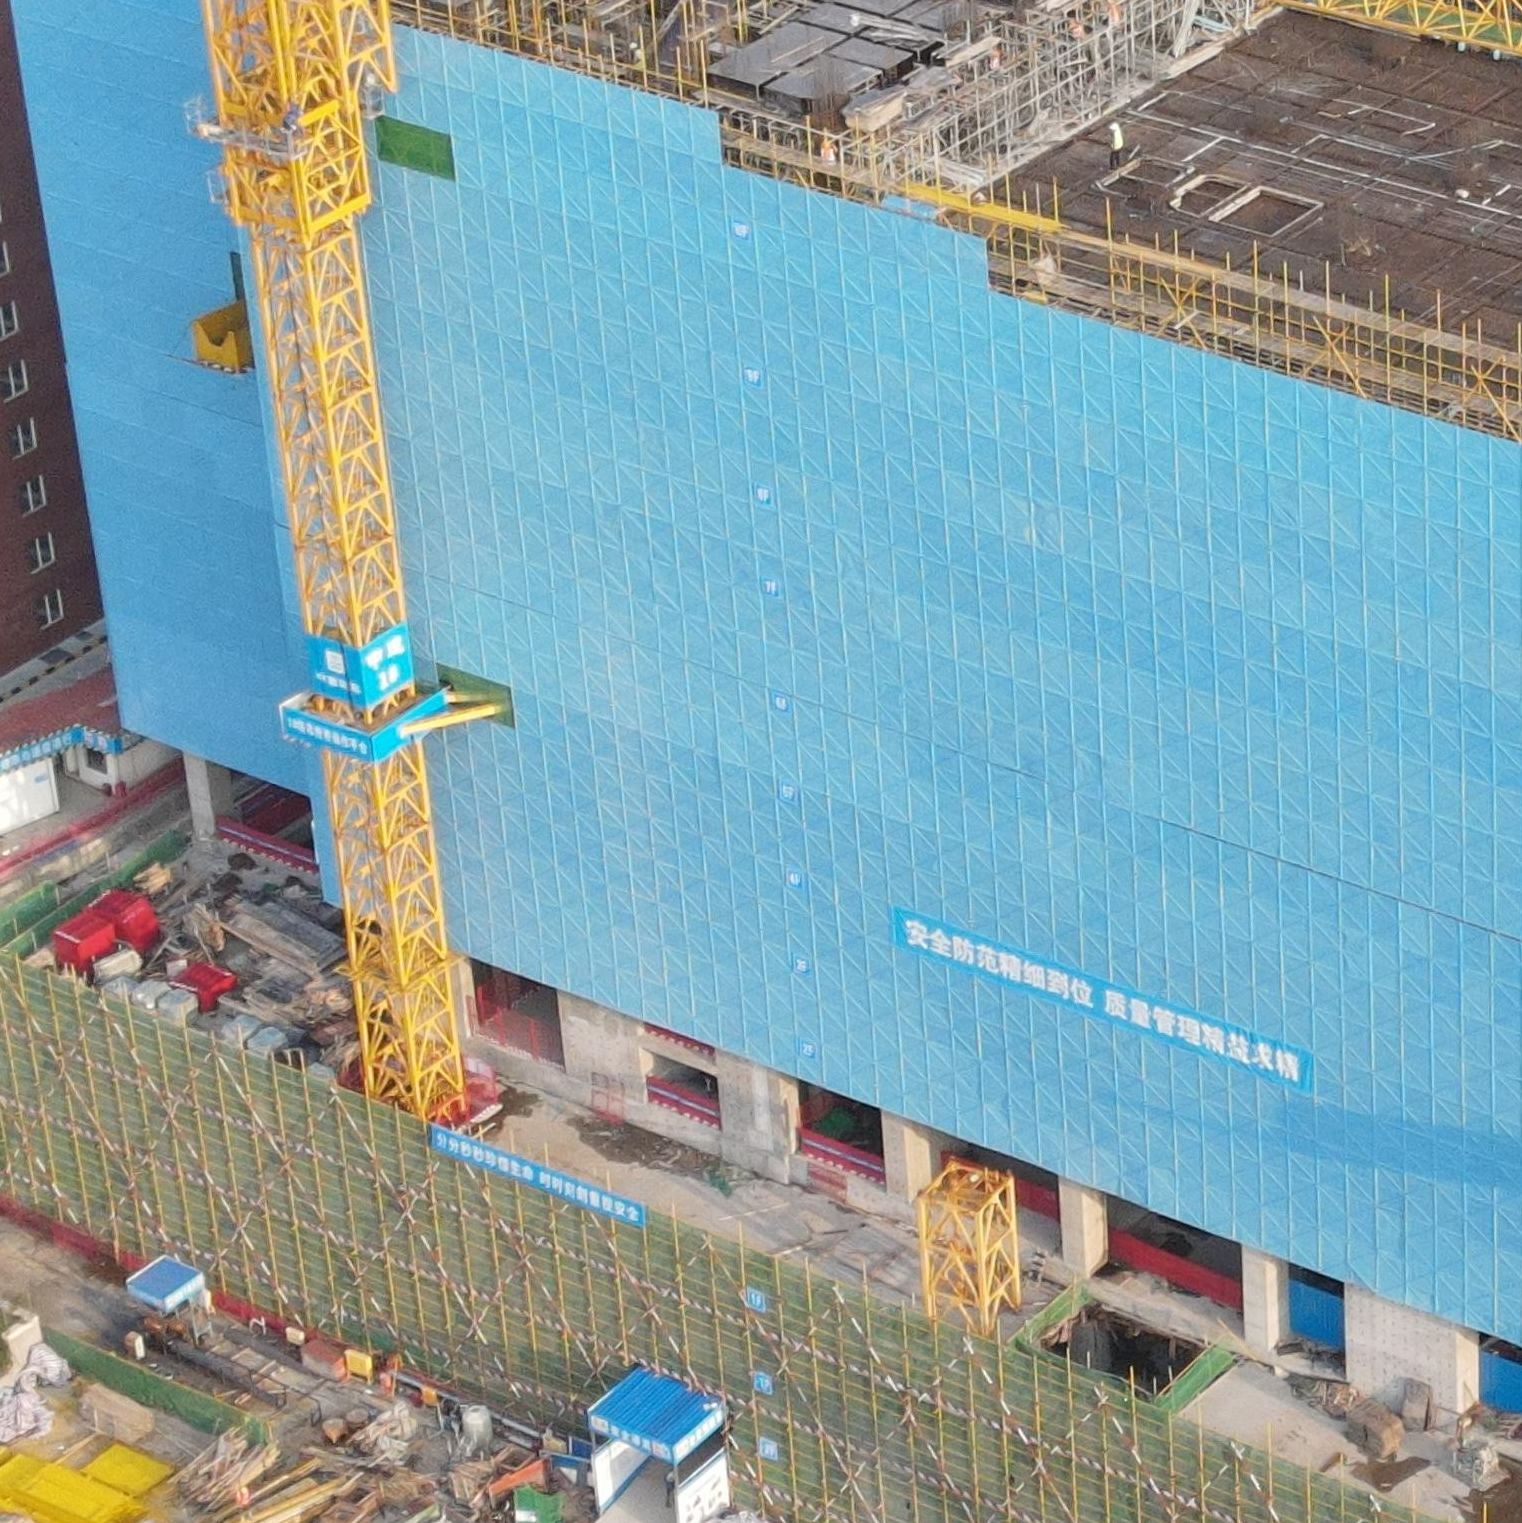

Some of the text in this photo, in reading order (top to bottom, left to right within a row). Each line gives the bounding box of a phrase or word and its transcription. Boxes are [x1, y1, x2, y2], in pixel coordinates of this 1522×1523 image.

[905, 918, 1300, 1081] 安全防范精细到位 质量管理精益求精
